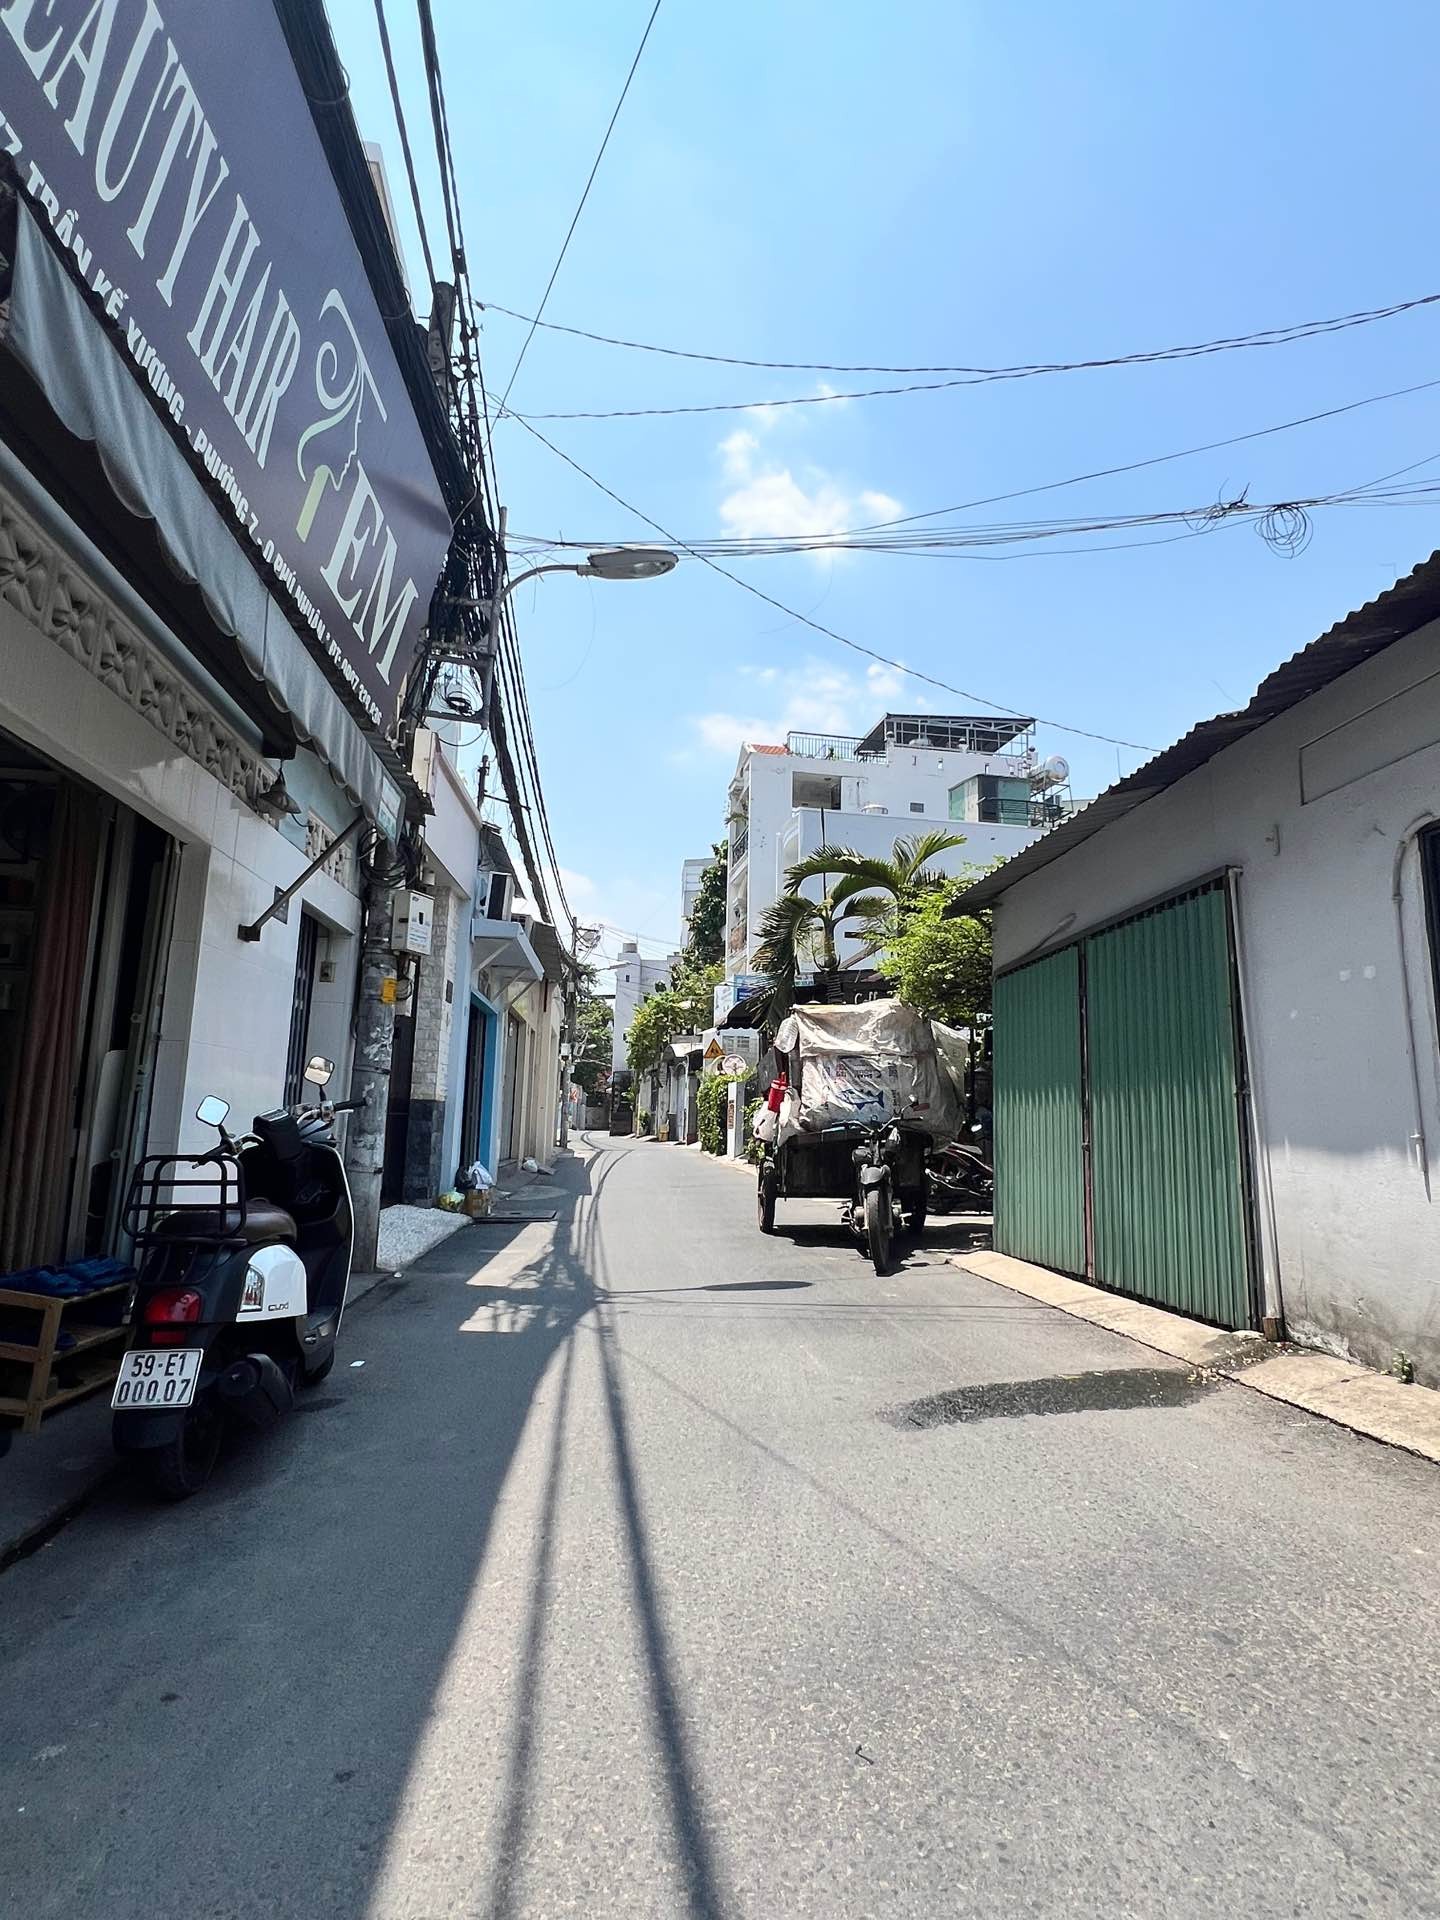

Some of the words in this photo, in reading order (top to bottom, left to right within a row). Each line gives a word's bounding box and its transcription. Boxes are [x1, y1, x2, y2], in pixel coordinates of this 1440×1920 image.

[27, 160, 93, 276] TRẦN
[127, 316, 185, 424] XƯƠNG
[193, 428, 249, 523] PHƯỜNG
[274, 552, 298, 595] PHÚ
[186, 193, 301, 469] HAIR
[320, 460, 419, 685] EM
[118, 1379, 191, 1403] 000.07
[131, 1353, 186, 1377] 59-E1
